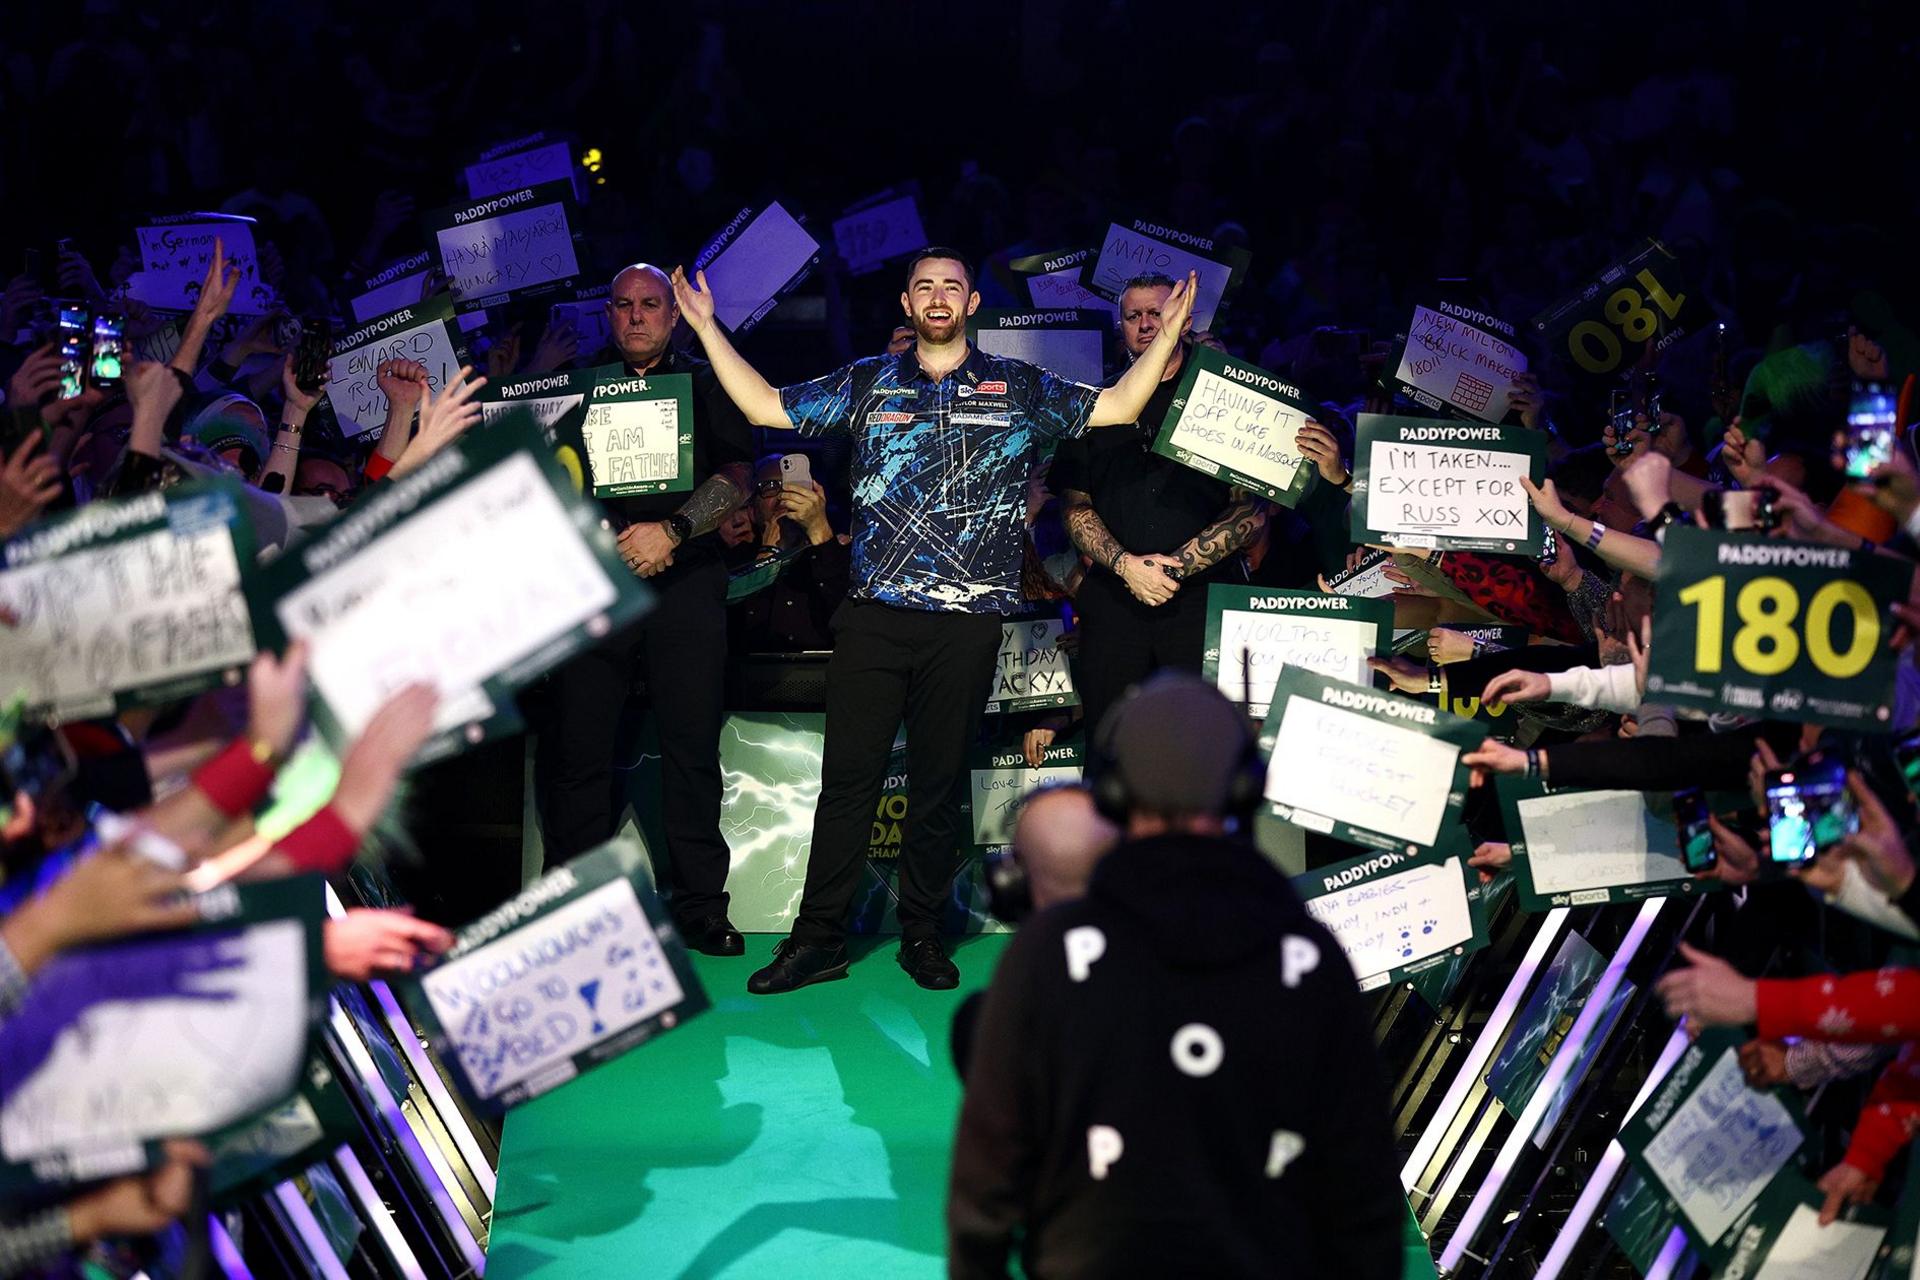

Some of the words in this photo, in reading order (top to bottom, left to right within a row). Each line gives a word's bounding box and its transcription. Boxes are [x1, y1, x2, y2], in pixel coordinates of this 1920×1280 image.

[453, 189, 535, 223] PADDYPOWER
[694, 206, 753, 270] PADDYPOWER
[1134, 219, 1215, 252] PADDYPOWER
[1043, 249, 1087, 272] PADDYP
[1107, 238, 1171, 268] MAYO
[334, 308, 415, 354] PADDYPOWER
[999, 310, 1080, 328] PADDYPOWER
[1439, 301, 1516, 337] PADDYPOWER
[1567, 267, 1688, 374] 180
[1423, 312, 1458, 333] NEW
[1462, 326, 1516, 360] MILTON
[501, 374, 570, 398] PADDYPOWER
[872, 388, 917, 396] PADDYPOWER
[960, 387, 975, 396] sky
[976, 382, 1005, 393] sports
[1223, 364, 1301, 400] PADDYPOWER
[1401, 385, 1417, 399] sky
[977, 400, 1009, 408] MAXWELL
[1202, 378, 1268, 418] HAVING
[1273, 410, 1295, 429] IT
[1192, 403, 1229, 423] OFF
[1234, 415, 1270, 440] LIKE
[1399, 427, 1502, 442] PADDYPOWER
[606, 426, 645, 453] AM
[1179, 415, 1227, 444] SHOES
[1230, 436, 1246, 452] IN
[1246, 441, 1258, 456] A
[1257, 443, 1302, 470] MOSQUE
[1175, 450, 1192, 463] sky
[1191, 456, 1218, 474] sports
[1378, 475, 1467, 498] EXCEPT
[1476, 479, 1516, 497] FOR
[1401, 502, 1461, 524] RUSS
[1474, 508, 1524, 528] XOX
[1717, 542, 1851, 568] PADDYPOWER
[1249, 596, 1349, 611] PADDYPOWER
[1678, 574, 1882, 680] 180
[1321, 686, 1436, 724] PADDYPOWER
[979, 776, 1023, 791] Love
[446, 865, 578, 961] PADDYPOWER
[1375, 901, 1409, 921] INDY
[1551, 894, 1570, 906] sky
[1571, 890, 1609, 903] sports
[1064, 925, 1108, 983] P
[1279, 934, 1323, 989] P
[1168, 1022, 1227, 1079] O
[1086, 1124, 1125, 1181] P
[1263, 1128, 1308, 1180] P
